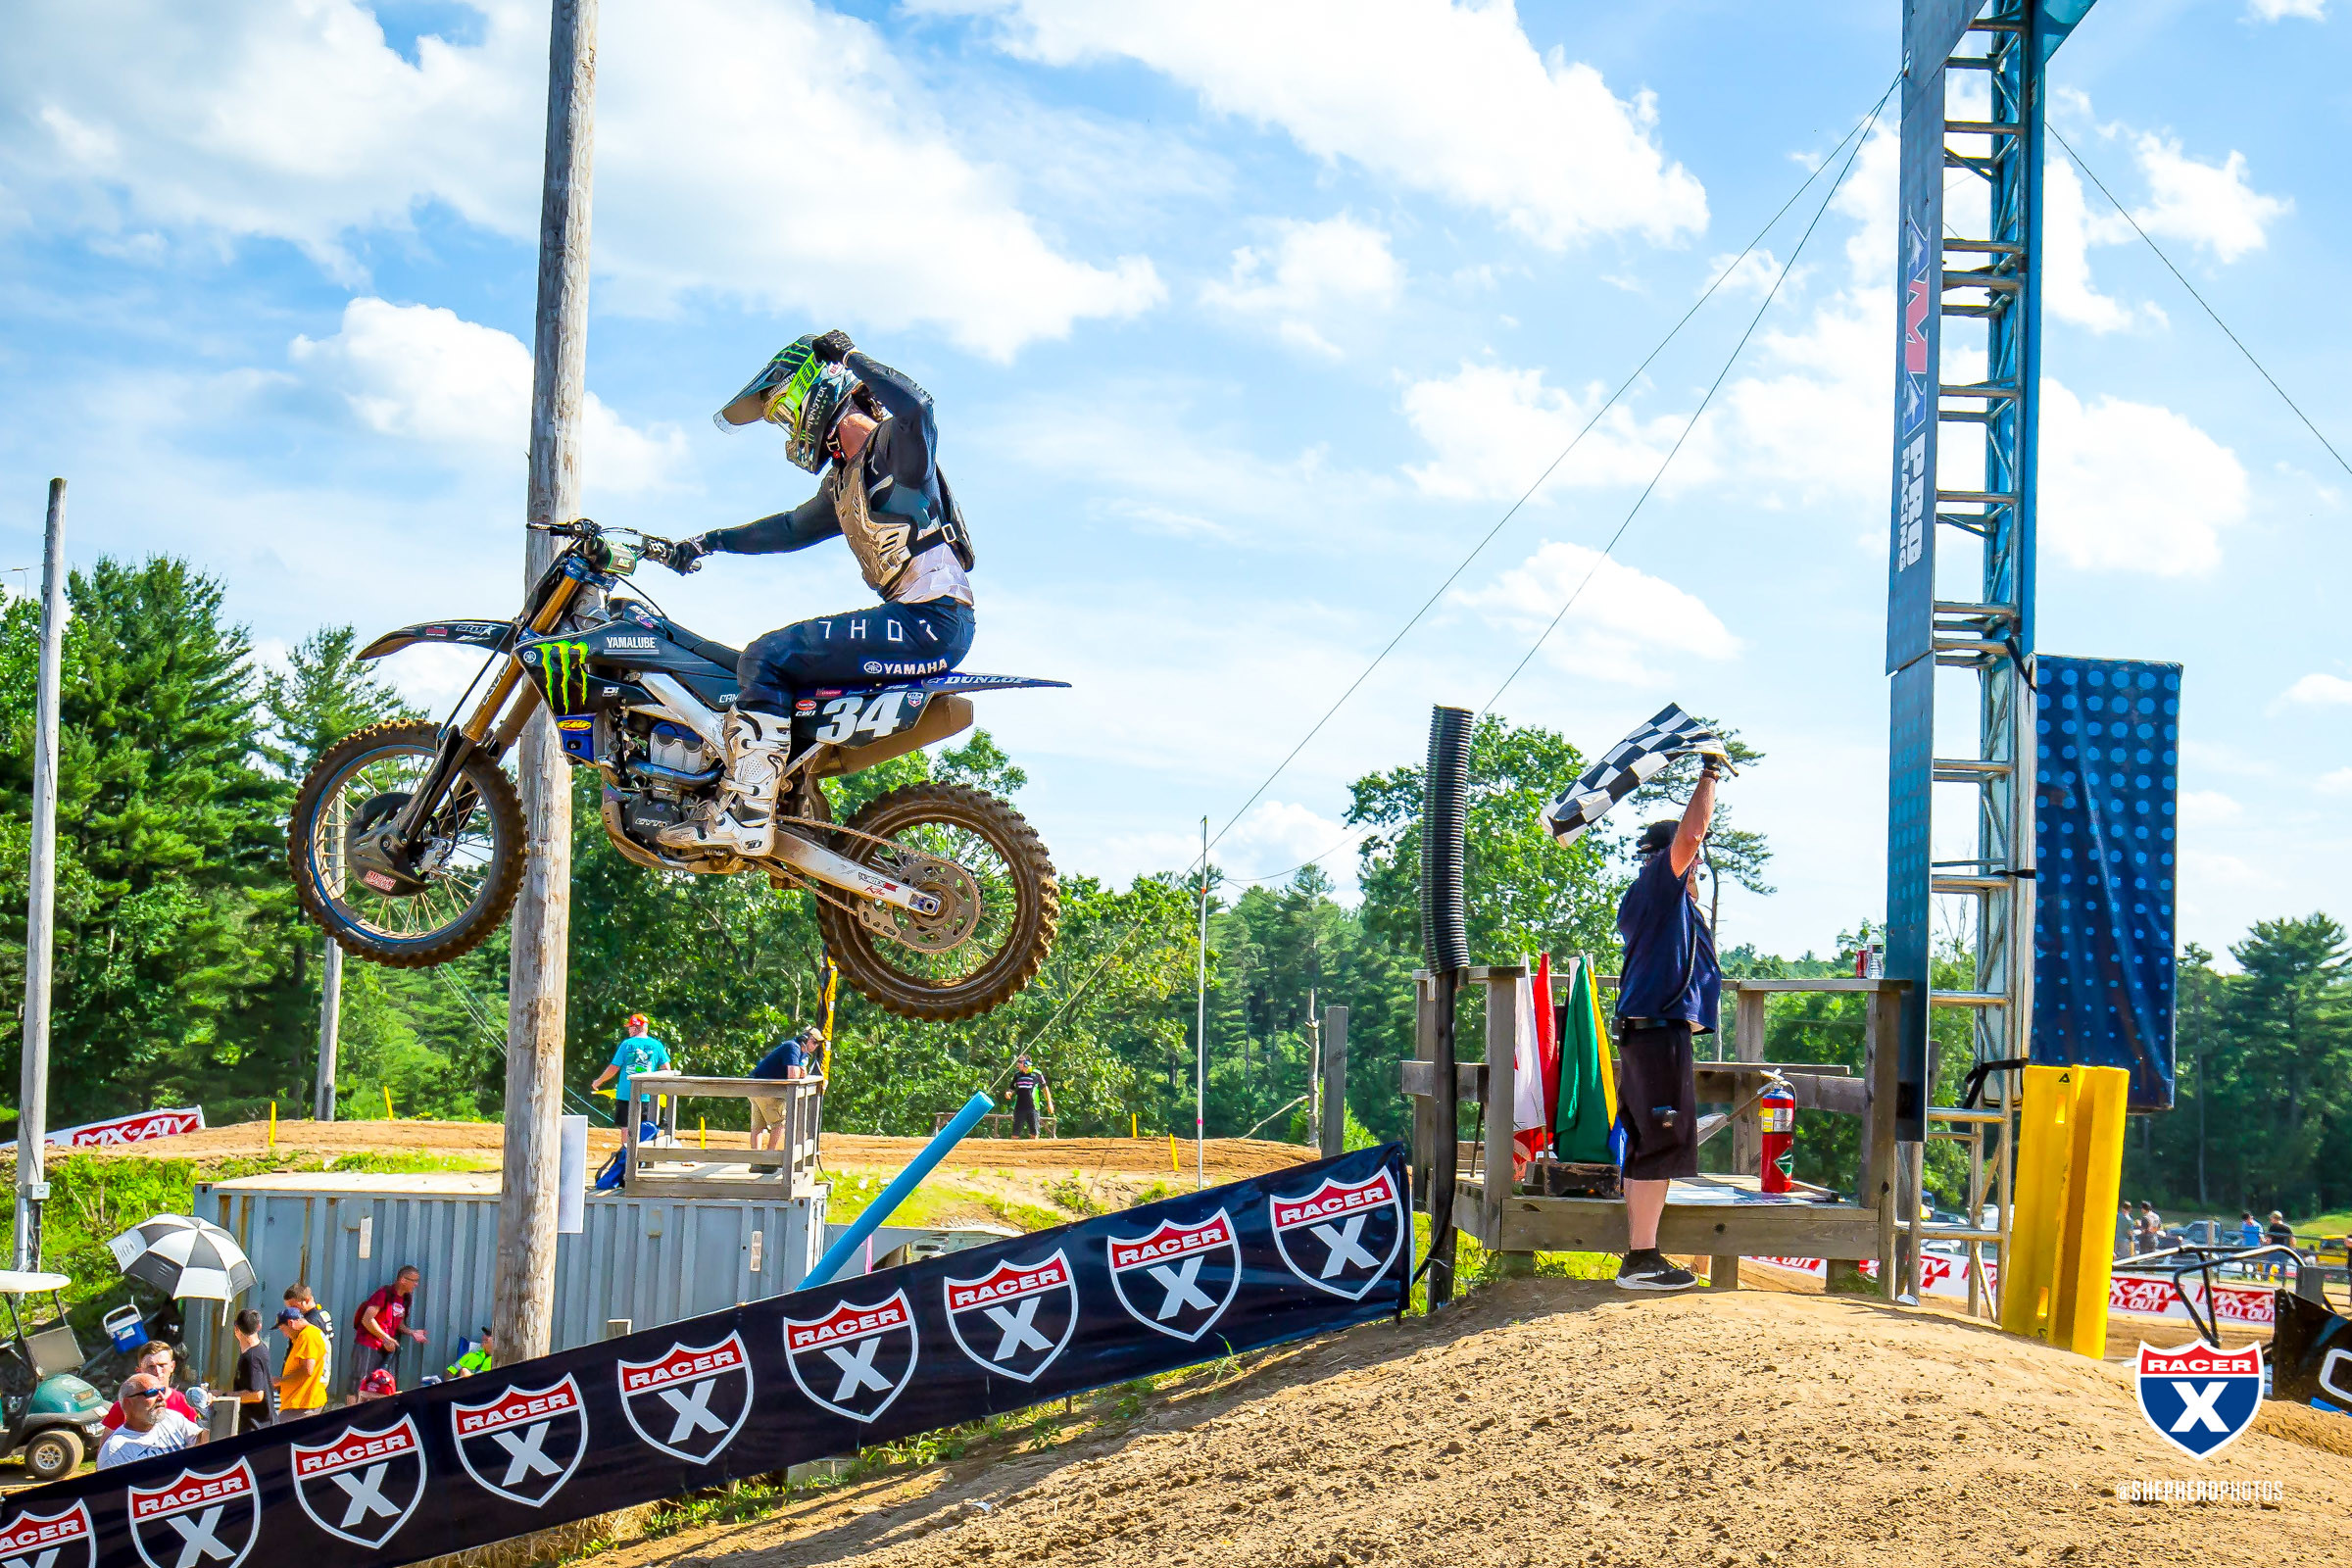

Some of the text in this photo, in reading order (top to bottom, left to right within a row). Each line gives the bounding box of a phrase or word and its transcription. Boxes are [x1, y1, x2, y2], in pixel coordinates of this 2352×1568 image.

[1903, 205, 1931, 439] AMA
[807, 385, 828, 429] MONSTER
[1898, 447, 1910, 572] RACING
[1907, 432, 1926, 566] PRO
[606, 637, 656, 649] YAMALUBE
[884, 659, 948, 675] YAMAHA
[945, 675, 1027, 684] DUNLOP
[815, 691, 907, 745] 34
[138, 1115, 195, 1141] ATV
[1280, 1187, 1386, 1224] RACER
[1117, 1228, 1223, 1265] RACER
[1309, 1213, 1382, 1280] X
[955, 1268, 1060, 1306] RACER
[1147, 1254, 1218, 1321] X
[2109, 1296, 2163, 1310] LL OUT
[794, 1308, 901, 1347] RACER
[982, 1296, 1054, 1362] X
[628, 1350, 736, 1389] RACER
[822, 1337, 895, 1402] X
[463, 1393, 569, 1431] RACER
[658, 1378, 730, 1445] X
[301, 1434, 408, 1472] RACER
[491, 1420, 564, 1488] X
[138, 1477, 243, 1515] RACER
[329, 1461, 403, 1529] X
[0, 1519, 79, 1551] ACER
[166, 1504, 237, 1568] X
